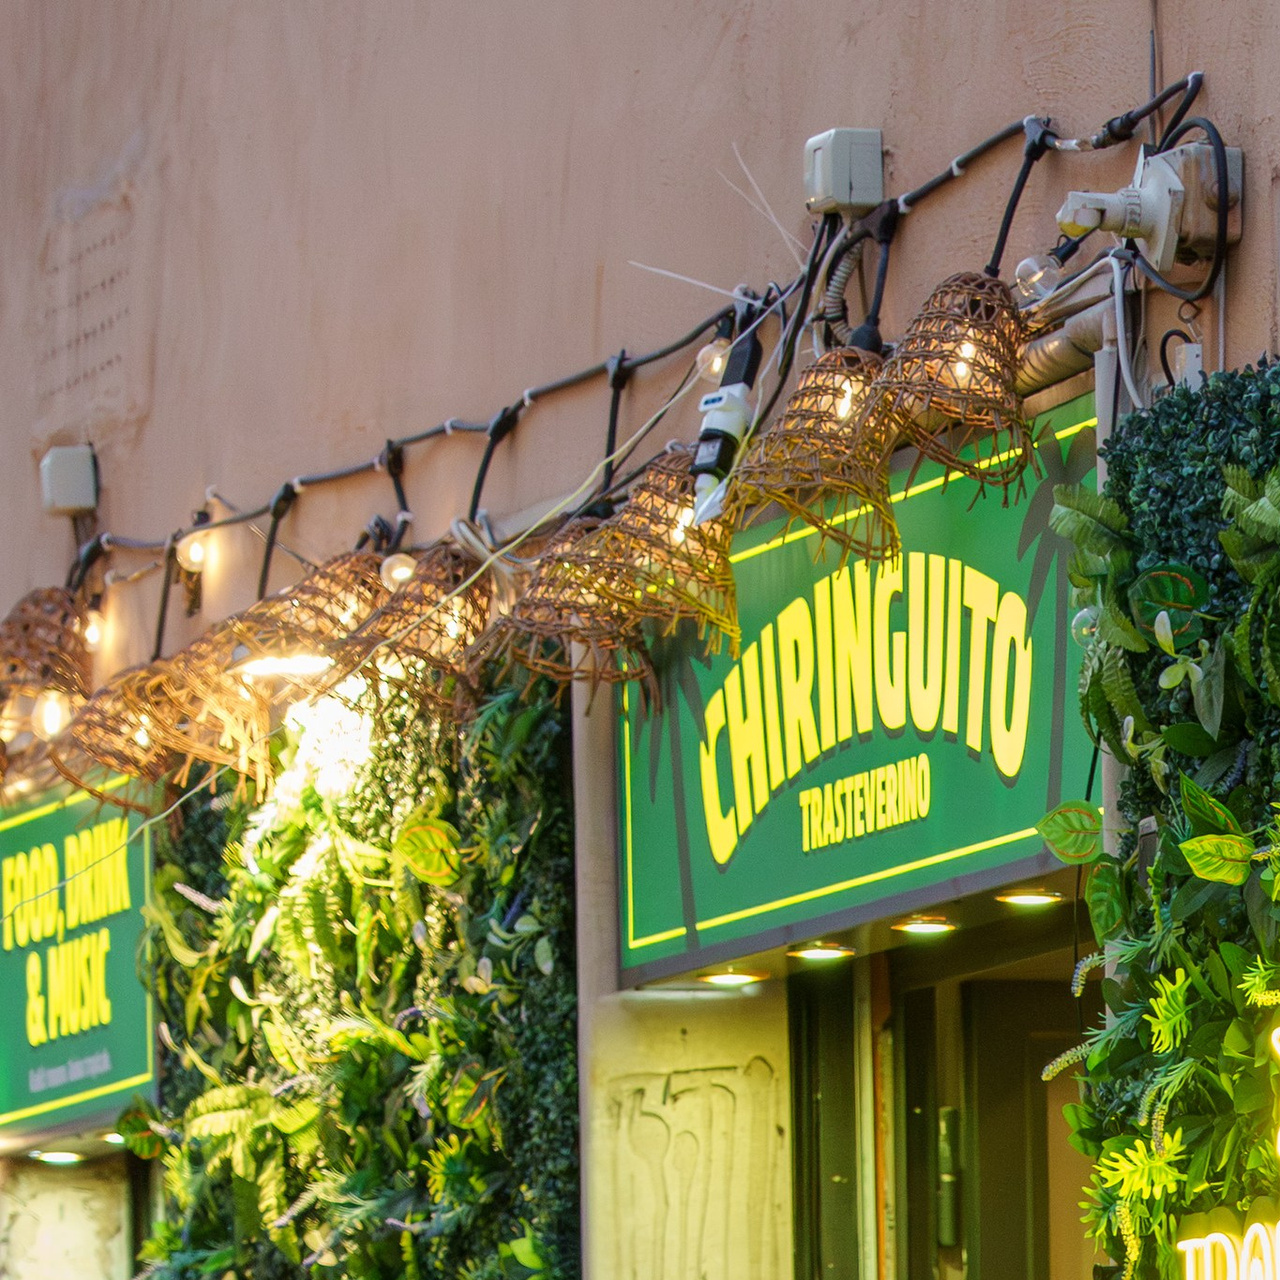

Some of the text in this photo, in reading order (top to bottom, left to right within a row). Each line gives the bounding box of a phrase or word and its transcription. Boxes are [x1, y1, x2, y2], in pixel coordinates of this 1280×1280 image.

[700, 551, 1033, 866] CHIRINGUITO
[799, 752, 931, 853] TRASTEVERINO
[1, 816, 131, 952] FOOD, DRINK
[25, 926, 112, 1047] & MUSIC
